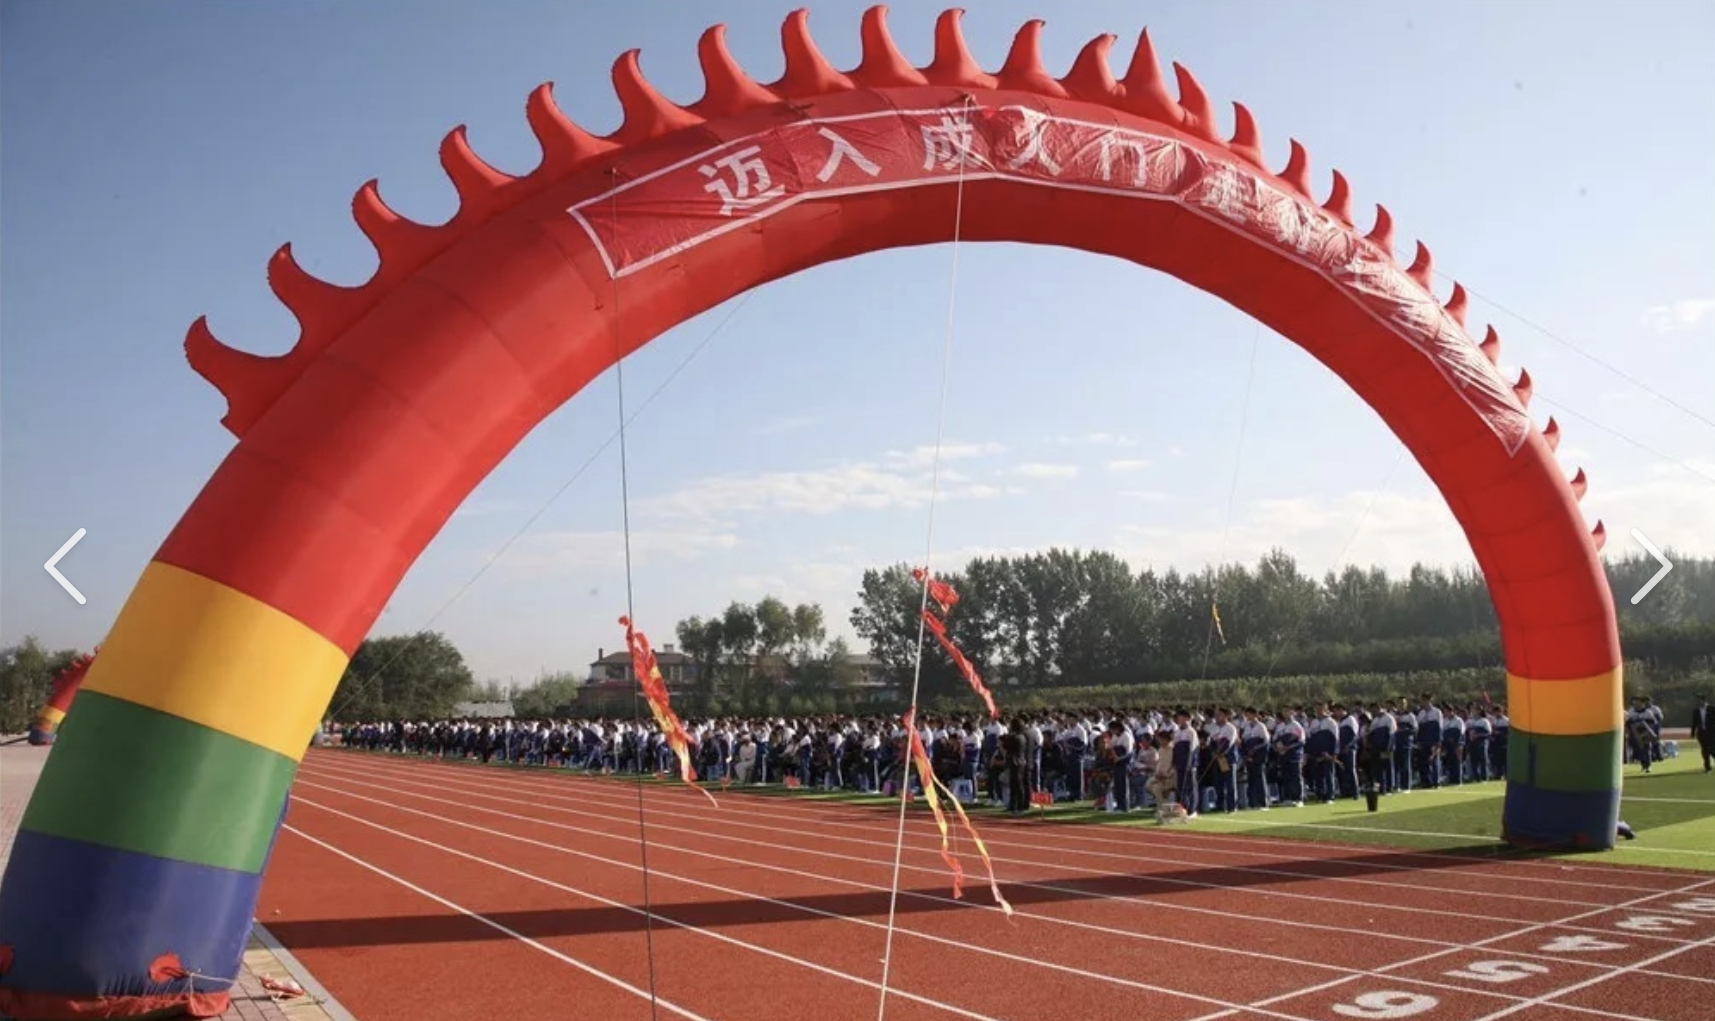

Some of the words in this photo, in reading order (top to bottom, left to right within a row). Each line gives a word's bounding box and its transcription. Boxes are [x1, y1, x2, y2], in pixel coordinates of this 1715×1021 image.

[1613, 915, 1697, 932] 3
[1537, 935, 1631, 951] 4
[1441, 960, 1550, 982] 5
[1331, 990, 1440, 1018] 6
